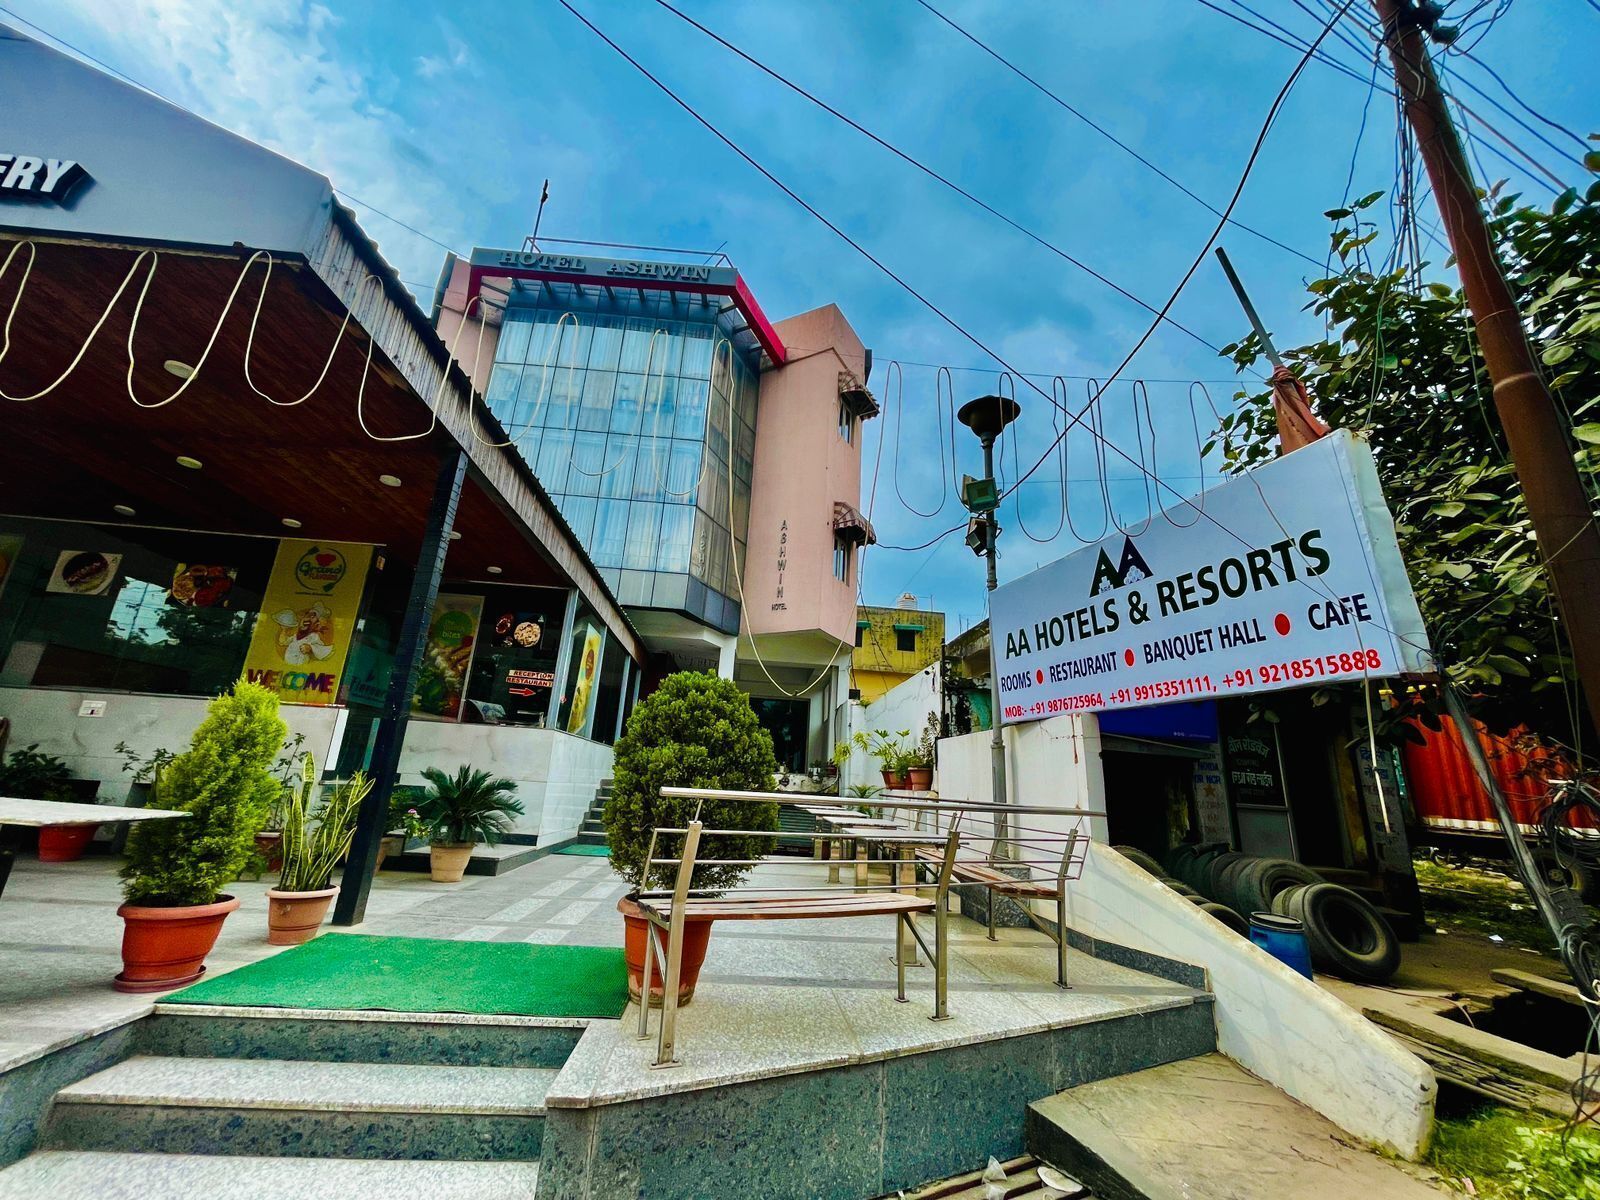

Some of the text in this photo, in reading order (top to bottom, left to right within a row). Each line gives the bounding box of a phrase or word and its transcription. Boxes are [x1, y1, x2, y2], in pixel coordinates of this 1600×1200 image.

[499, 252, 711, 281] HOTEL ASHWIN
[771, 603, 788, 611] HOTEL
[1006, 529, 1331, 659] AA HOTELS & RESORTS
[1001, 593, 1372, 692] ROOMS RESTAURANT BANQUET HALL CAFE
[513, 671, 552, 679] RECEPTION
[1030, 702, 1046, 714] +91
[1109, 689, 1130, 703] +91
[1223, 669, 1253, 687] +91
[1259, 648, 1382, 684] 9218515888
